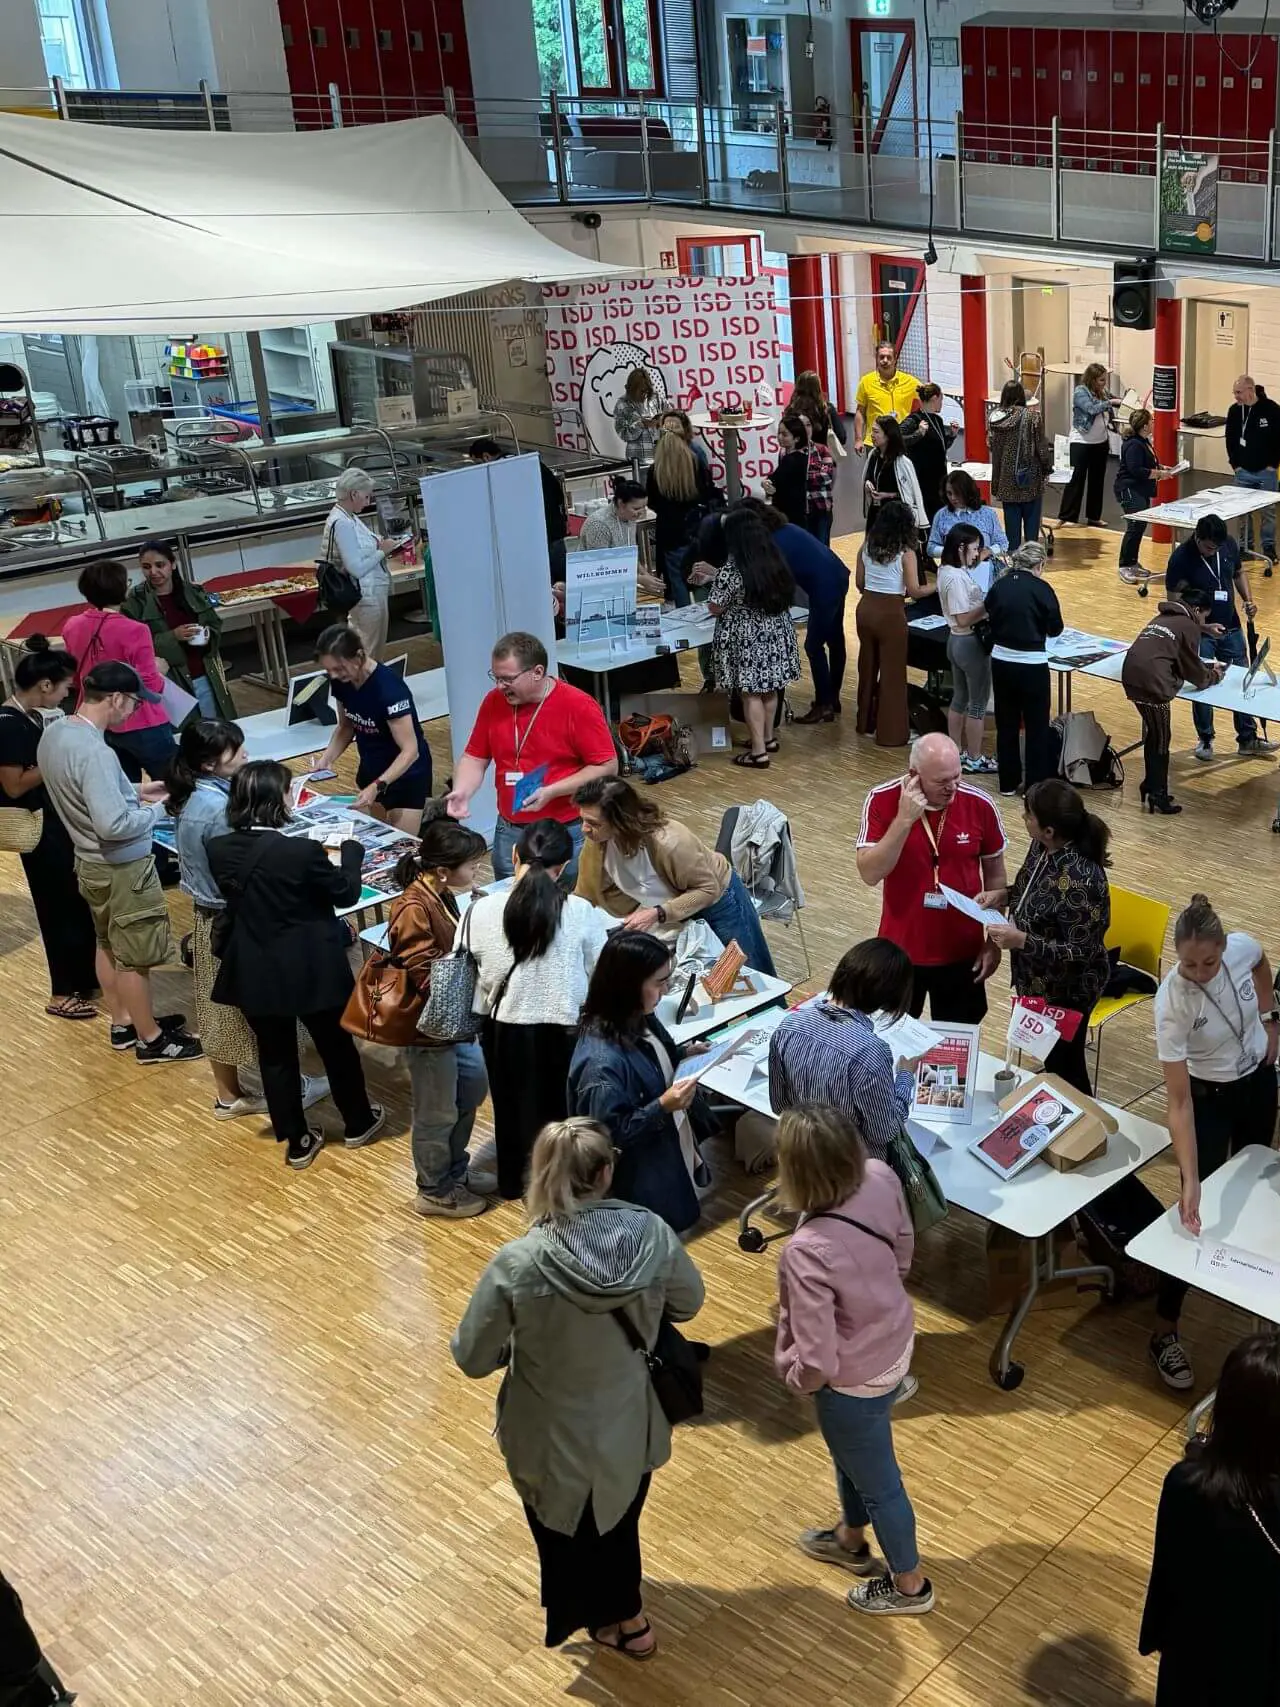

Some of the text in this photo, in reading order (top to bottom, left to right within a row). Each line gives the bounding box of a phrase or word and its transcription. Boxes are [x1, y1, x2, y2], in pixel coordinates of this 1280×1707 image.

[561, 303, 593, 325] ISD
[602, 297, 634, 320] ISD
[645, 295, 682, 315] ISD
[694, 293, 732, 312] ISD
[586, 326, 617, 348] ISD
[626, 321, 660, 342] ISD
[673, 318, 709, 339] ISD
[722, 316, 760, 337] ISD
[651, 345, 687, 366] ISD
[700, 342, 736, 362] ISD
[679, 368, 715, 389] ISD
[727, 365, 764, 385] ISD
[576, 568, 628, 579] WILLKOMMEN
[1019, 1014, 1044, 1034] ISD
[1041, 1006, 1066, 1020] ISD
[1230, 1256, 1274, 1276] International Market
